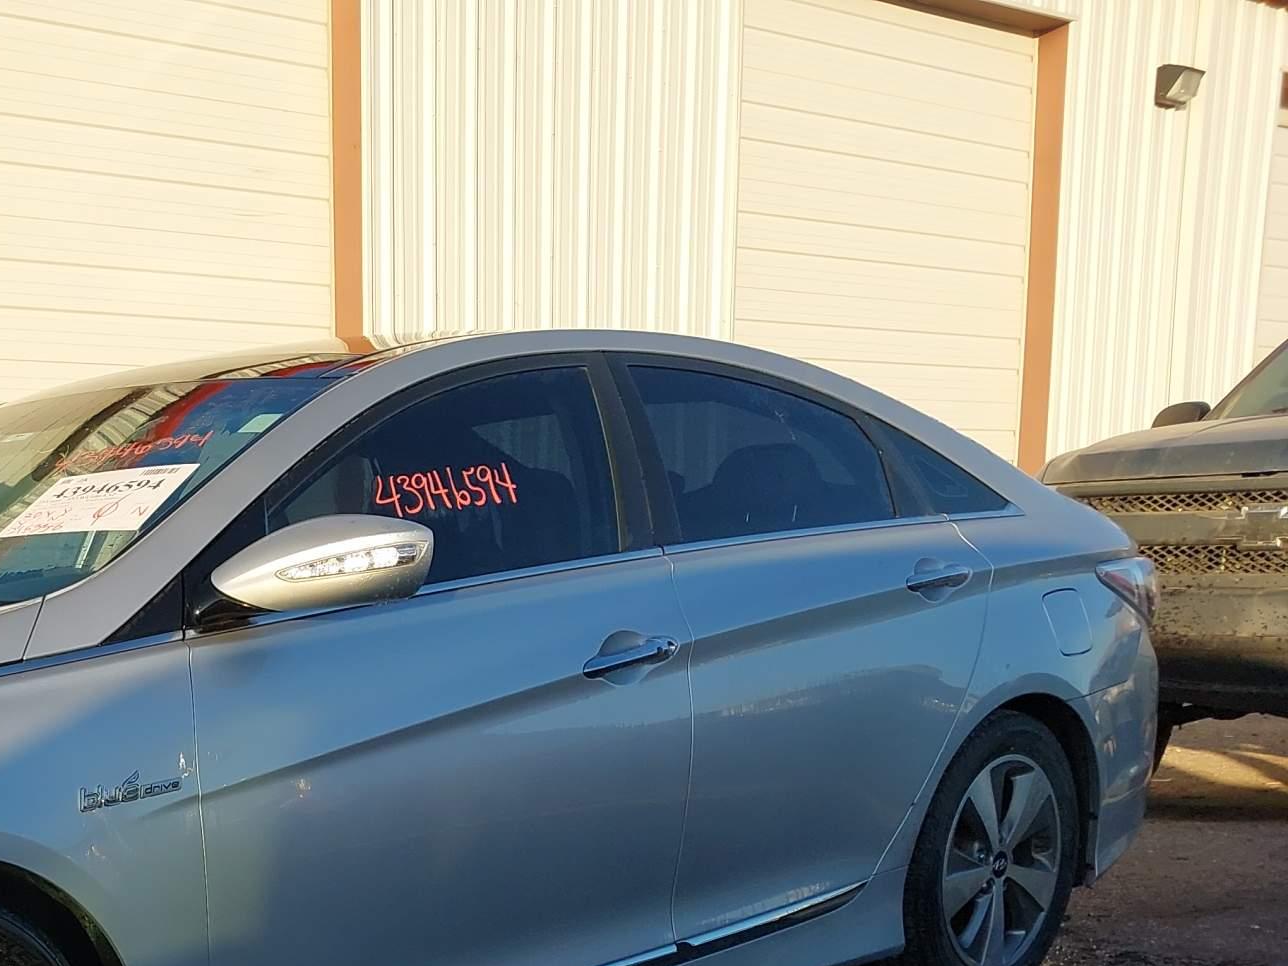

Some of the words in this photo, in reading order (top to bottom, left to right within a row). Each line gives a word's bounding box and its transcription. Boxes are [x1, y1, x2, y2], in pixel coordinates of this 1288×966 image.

[54, 478, 166, 499] 43946594
[374, 461, 517, 518] 43946594
[79, 778, 140, 813] blue
[144, 779, 181, 796] drive
